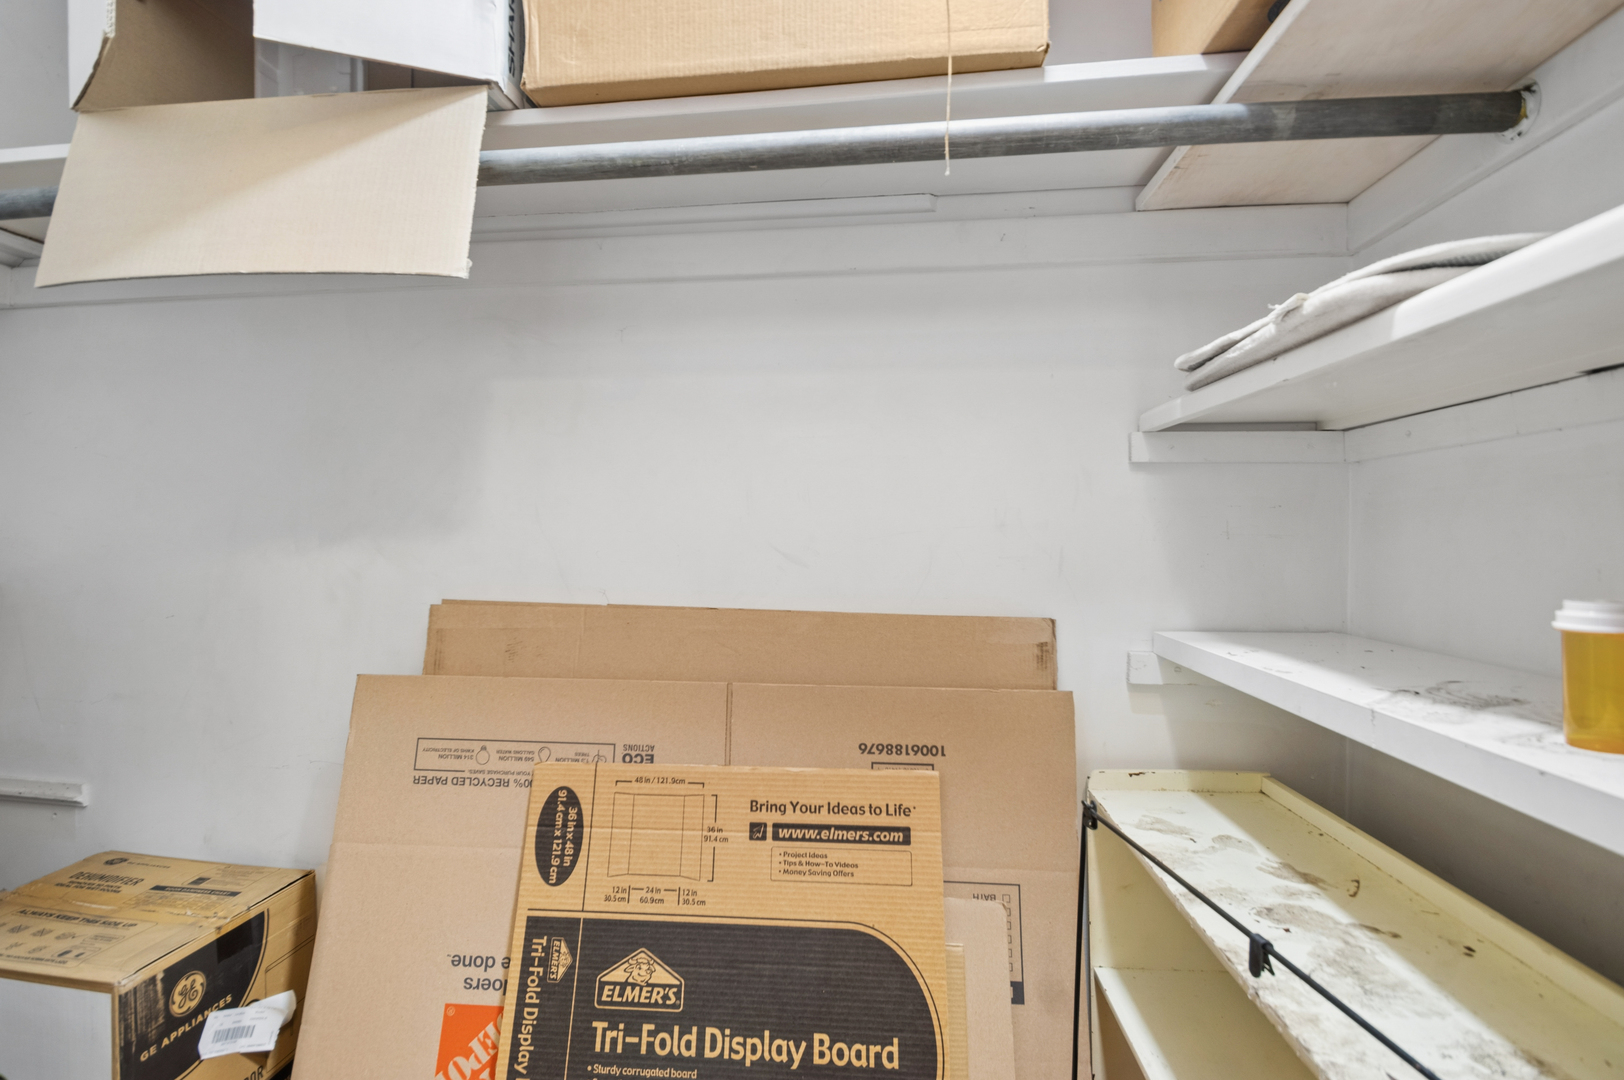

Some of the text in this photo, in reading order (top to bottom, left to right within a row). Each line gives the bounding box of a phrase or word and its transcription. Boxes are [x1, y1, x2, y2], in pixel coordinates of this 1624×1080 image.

[622, 744, 655, 752] ACTIONS
[858, 742, 946, 757] 1006188676
[622, 753, 655, 764] ECO
[413, 775, 448, 786] PAPER
[451, 776, 510, 787] RECYCLED
[556, 789, 567, 812] 91.4
[750, 800, 787, 816] Bring
[789, 800, 824, 814] Your
[827, 802, 866, 816] Ideas
[869, 803, 883, 816] to
[568, 806, 578, 820] 36
[778, 827, 904, 842] www.elmers.com
[550, 839, 562, 866] 121.9
[564, 841, 574, 854] 48
[783, 851, 807, 859] Project
[548, 866, 558, 884] cm
[783, 869, 807, 877] Money
[807, 869, 831, 877] Saving
[550, 940, 560, 979] ELMER'S
[601, 985, 677, 1005] ELMER'S
[514, 936, 548, 1074] Tri-Fold Display
[140, 1044, 158, 1062] GE
[161, 994, 232, 1049] APPLIANCES
[592, 1021, 899, 1069] Tri-Fold Display Board
[593, 1063, 698, 1079] Sturdy corrugated board
